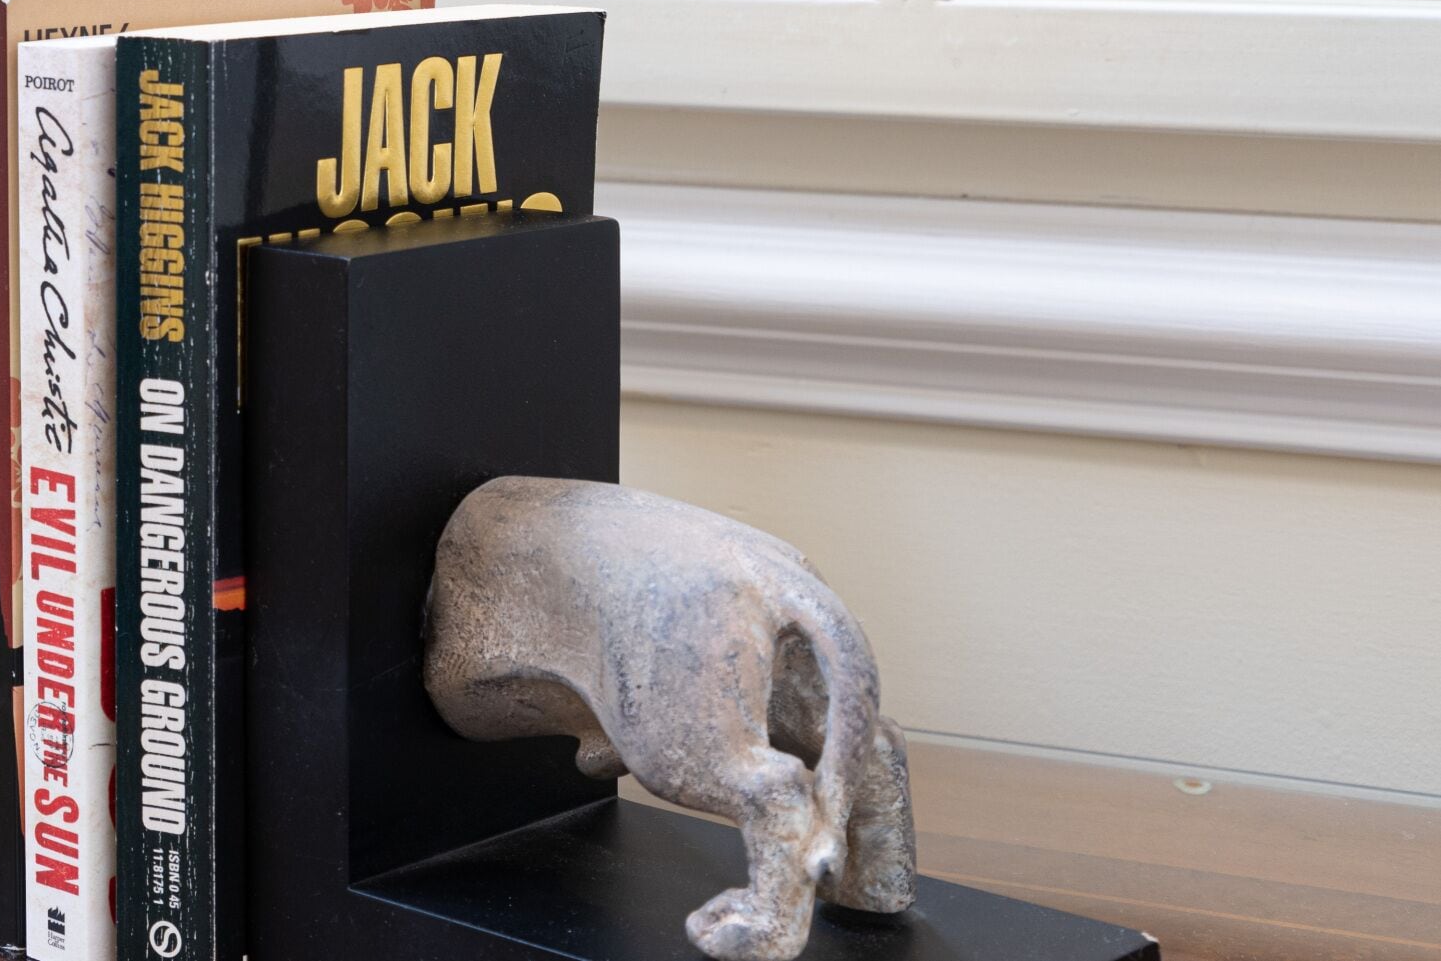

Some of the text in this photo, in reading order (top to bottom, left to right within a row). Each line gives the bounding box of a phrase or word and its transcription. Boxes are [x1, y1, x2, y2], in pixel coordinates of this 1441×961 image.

[24, 75, 75, 92] POIROT
[317, 52, 503, 219] JACK
[139, 69, 185, 343] JACK HIGGINS
[30, 466, 80, 896] EVIL UNDER THE SUN
[139, 378, 186, 835] ON DANGEROUS GROUND
[168, 850, 180, 909] ISBN 0 45
